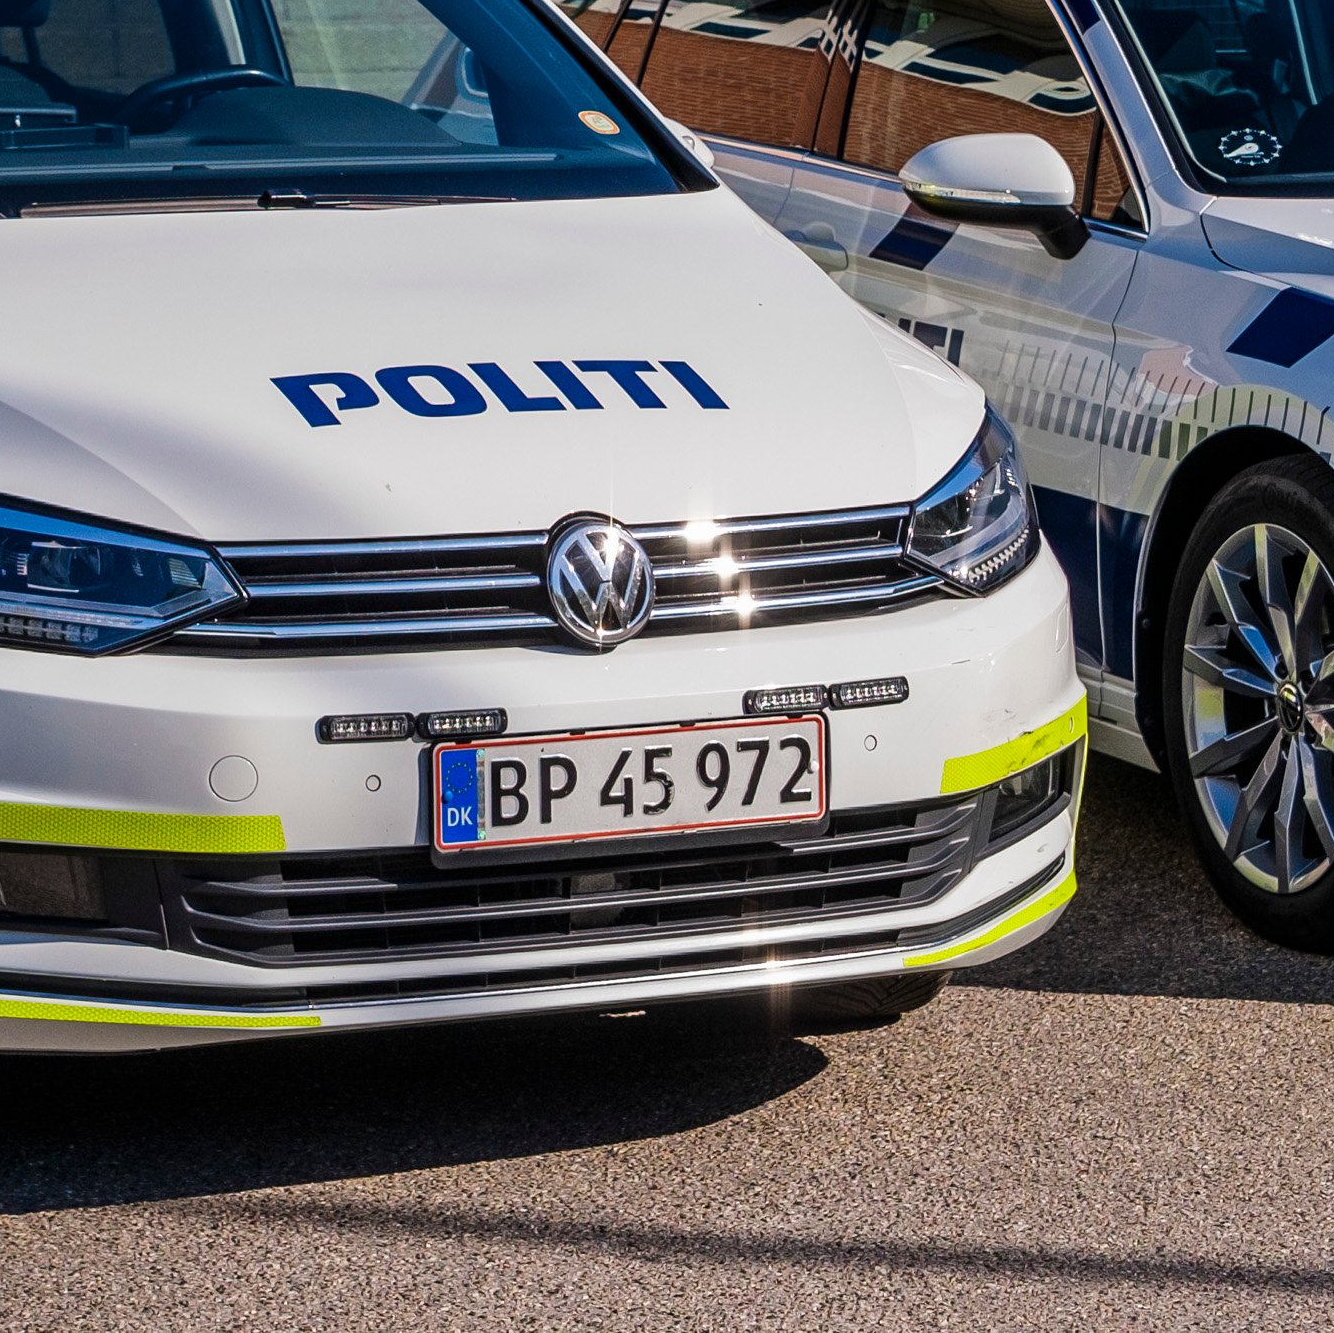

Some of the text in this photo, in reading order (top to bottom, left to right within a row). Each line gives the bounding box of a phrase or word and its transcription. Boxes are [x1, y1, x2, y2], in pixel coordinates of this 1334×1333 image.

[269, 360, 731, 428] POLITI
[490, 734, 812, 827] BP 45 972
[447, 806, 473, 827] DK
